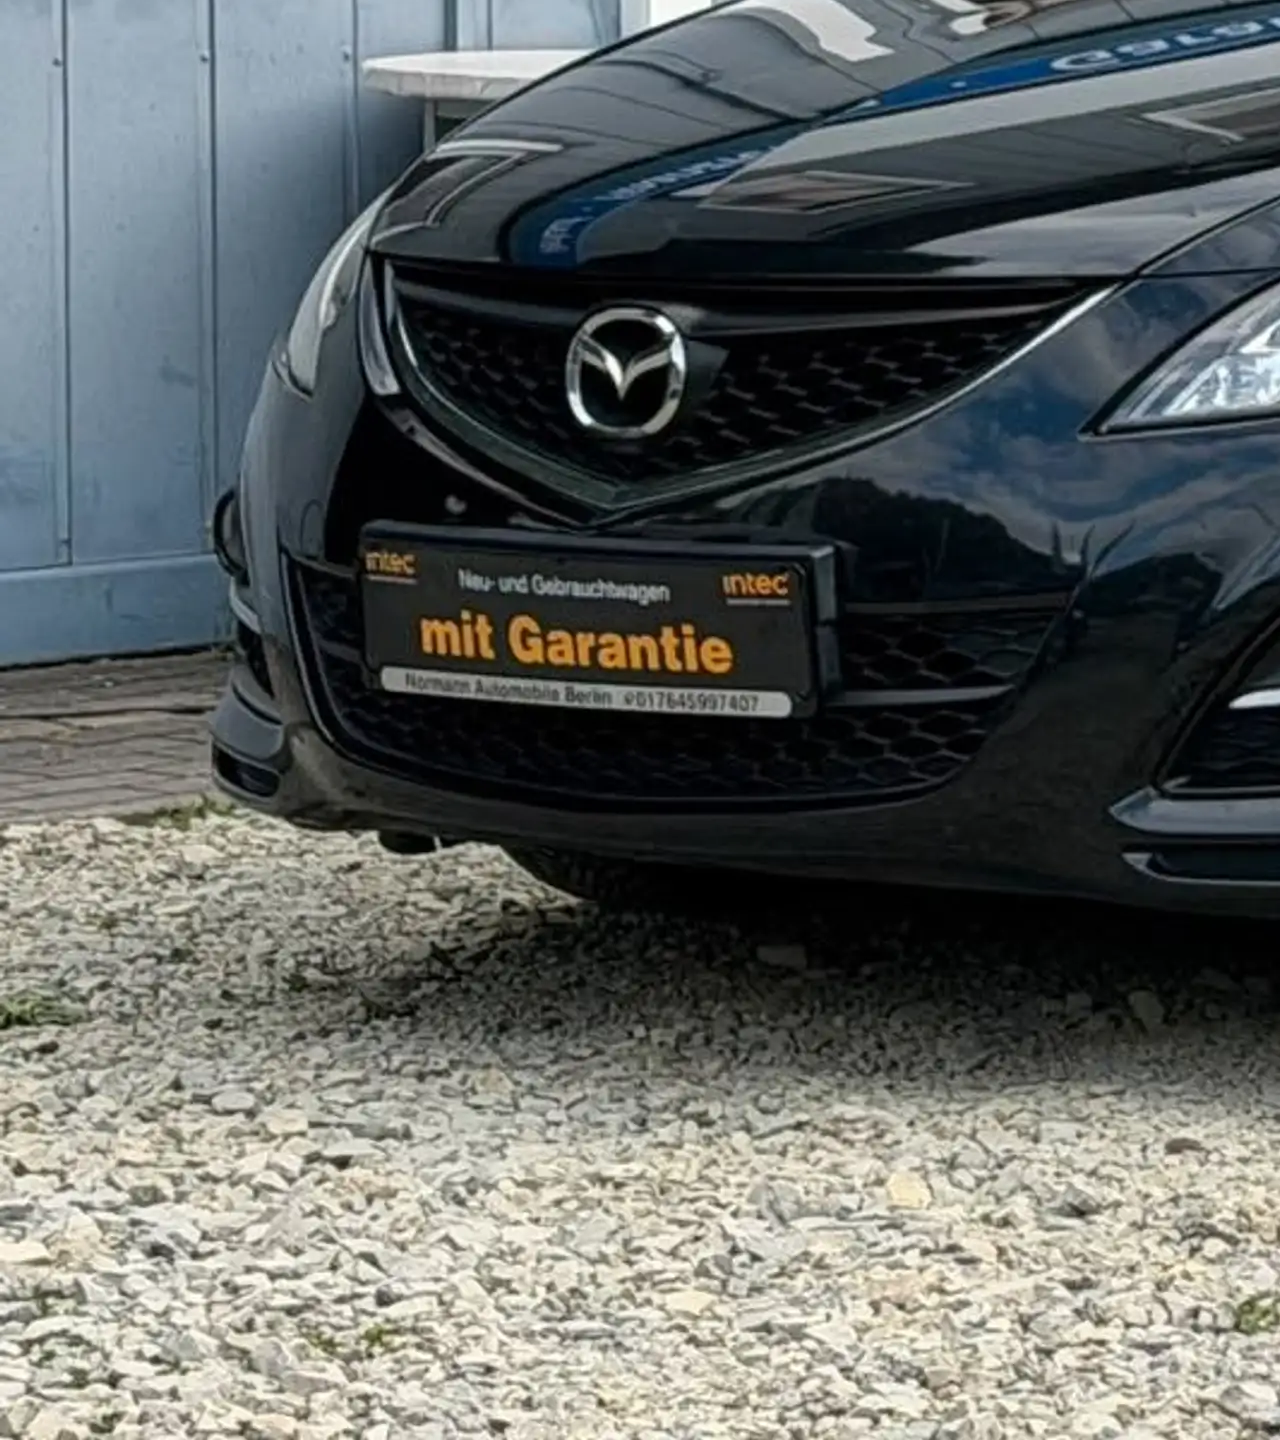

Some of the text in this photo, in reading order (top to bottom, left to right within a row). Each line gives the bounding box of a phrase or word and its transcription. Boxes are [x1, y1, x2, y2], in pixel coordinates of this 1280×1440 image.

[457, 568, 671, 606] Neu- und Gebrauchtwagen
[722, 572, 789, 596] intec
[419, 609, 734, 674] mit Garantie
[475, 679, 560, 703] Automobile
[564, 685, 612, 705] Berlin
